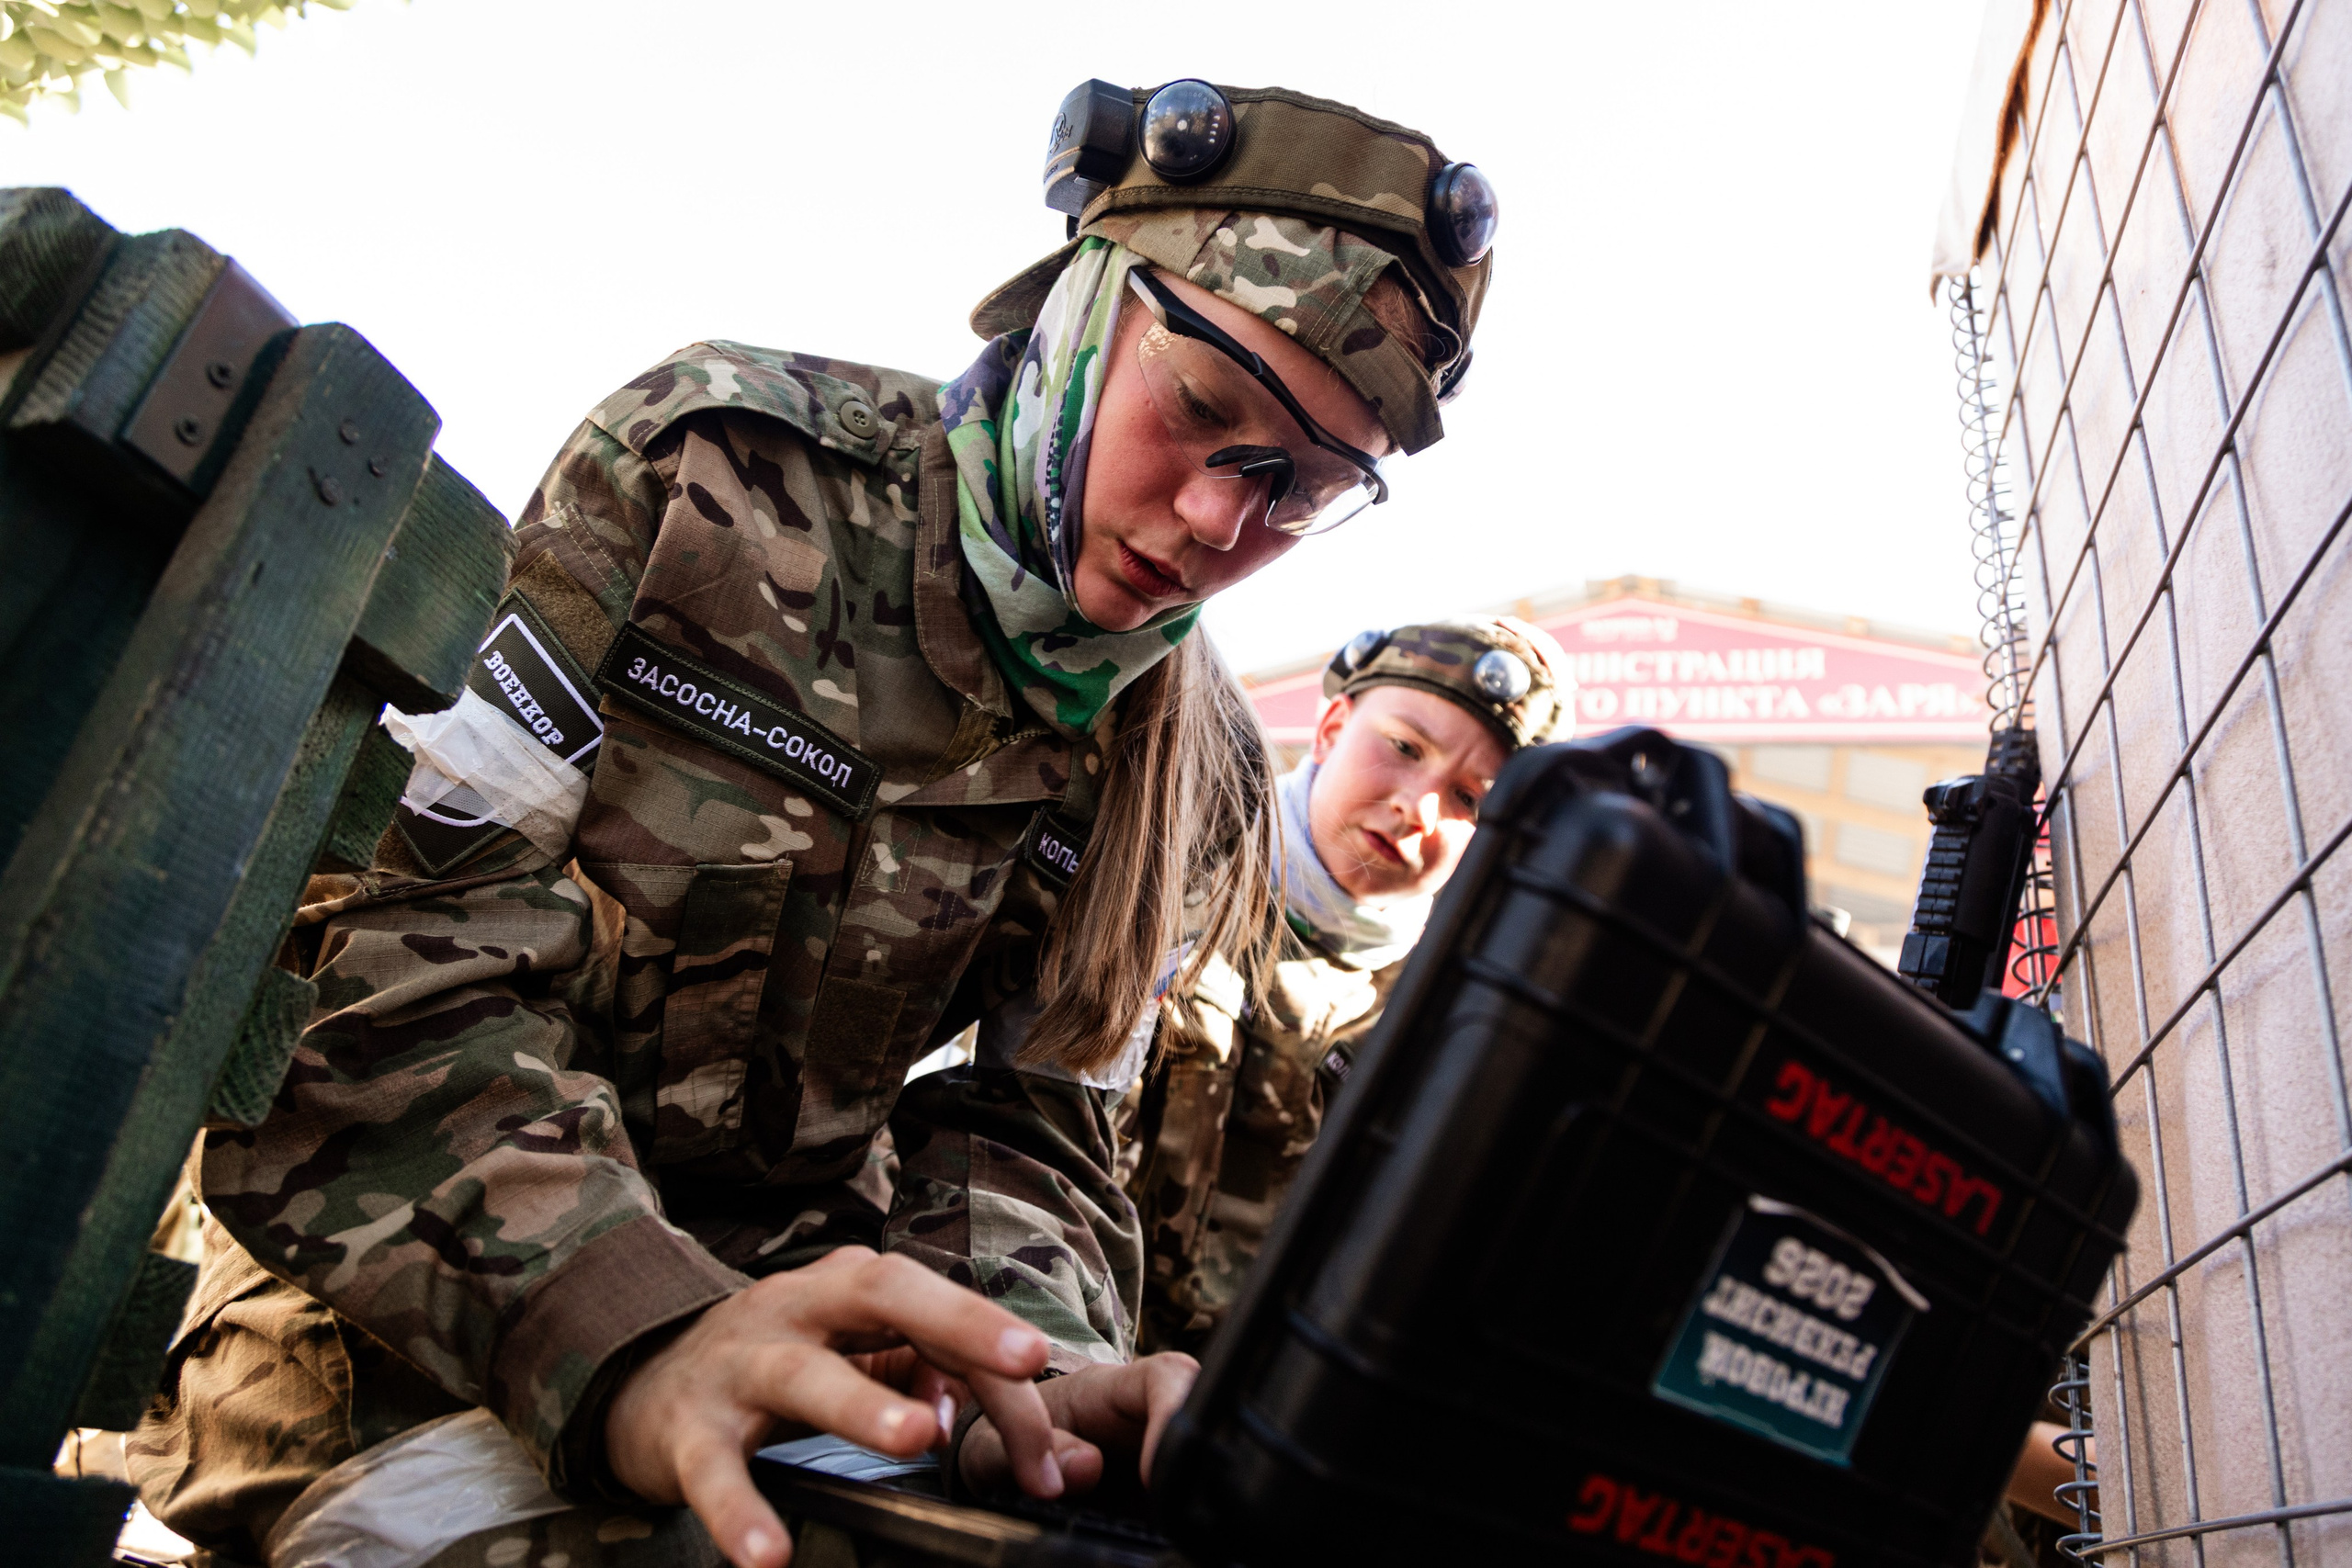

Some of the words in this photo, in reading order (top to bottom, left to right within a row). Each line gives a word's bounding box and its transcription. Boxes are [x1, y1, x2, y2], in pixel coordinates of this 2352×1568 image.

[484, 650, 564, 746] ВОЕНКОР
[628, 657, 854, 788] ЗАСОСНА-СОКОЛ
[1624, 685, 1808, 719] ПУНКТА
[1766, 1059, 2004, 1235] LASERTAG
[1696, 1330, 1851, 1429] ИГРОВОЙ
